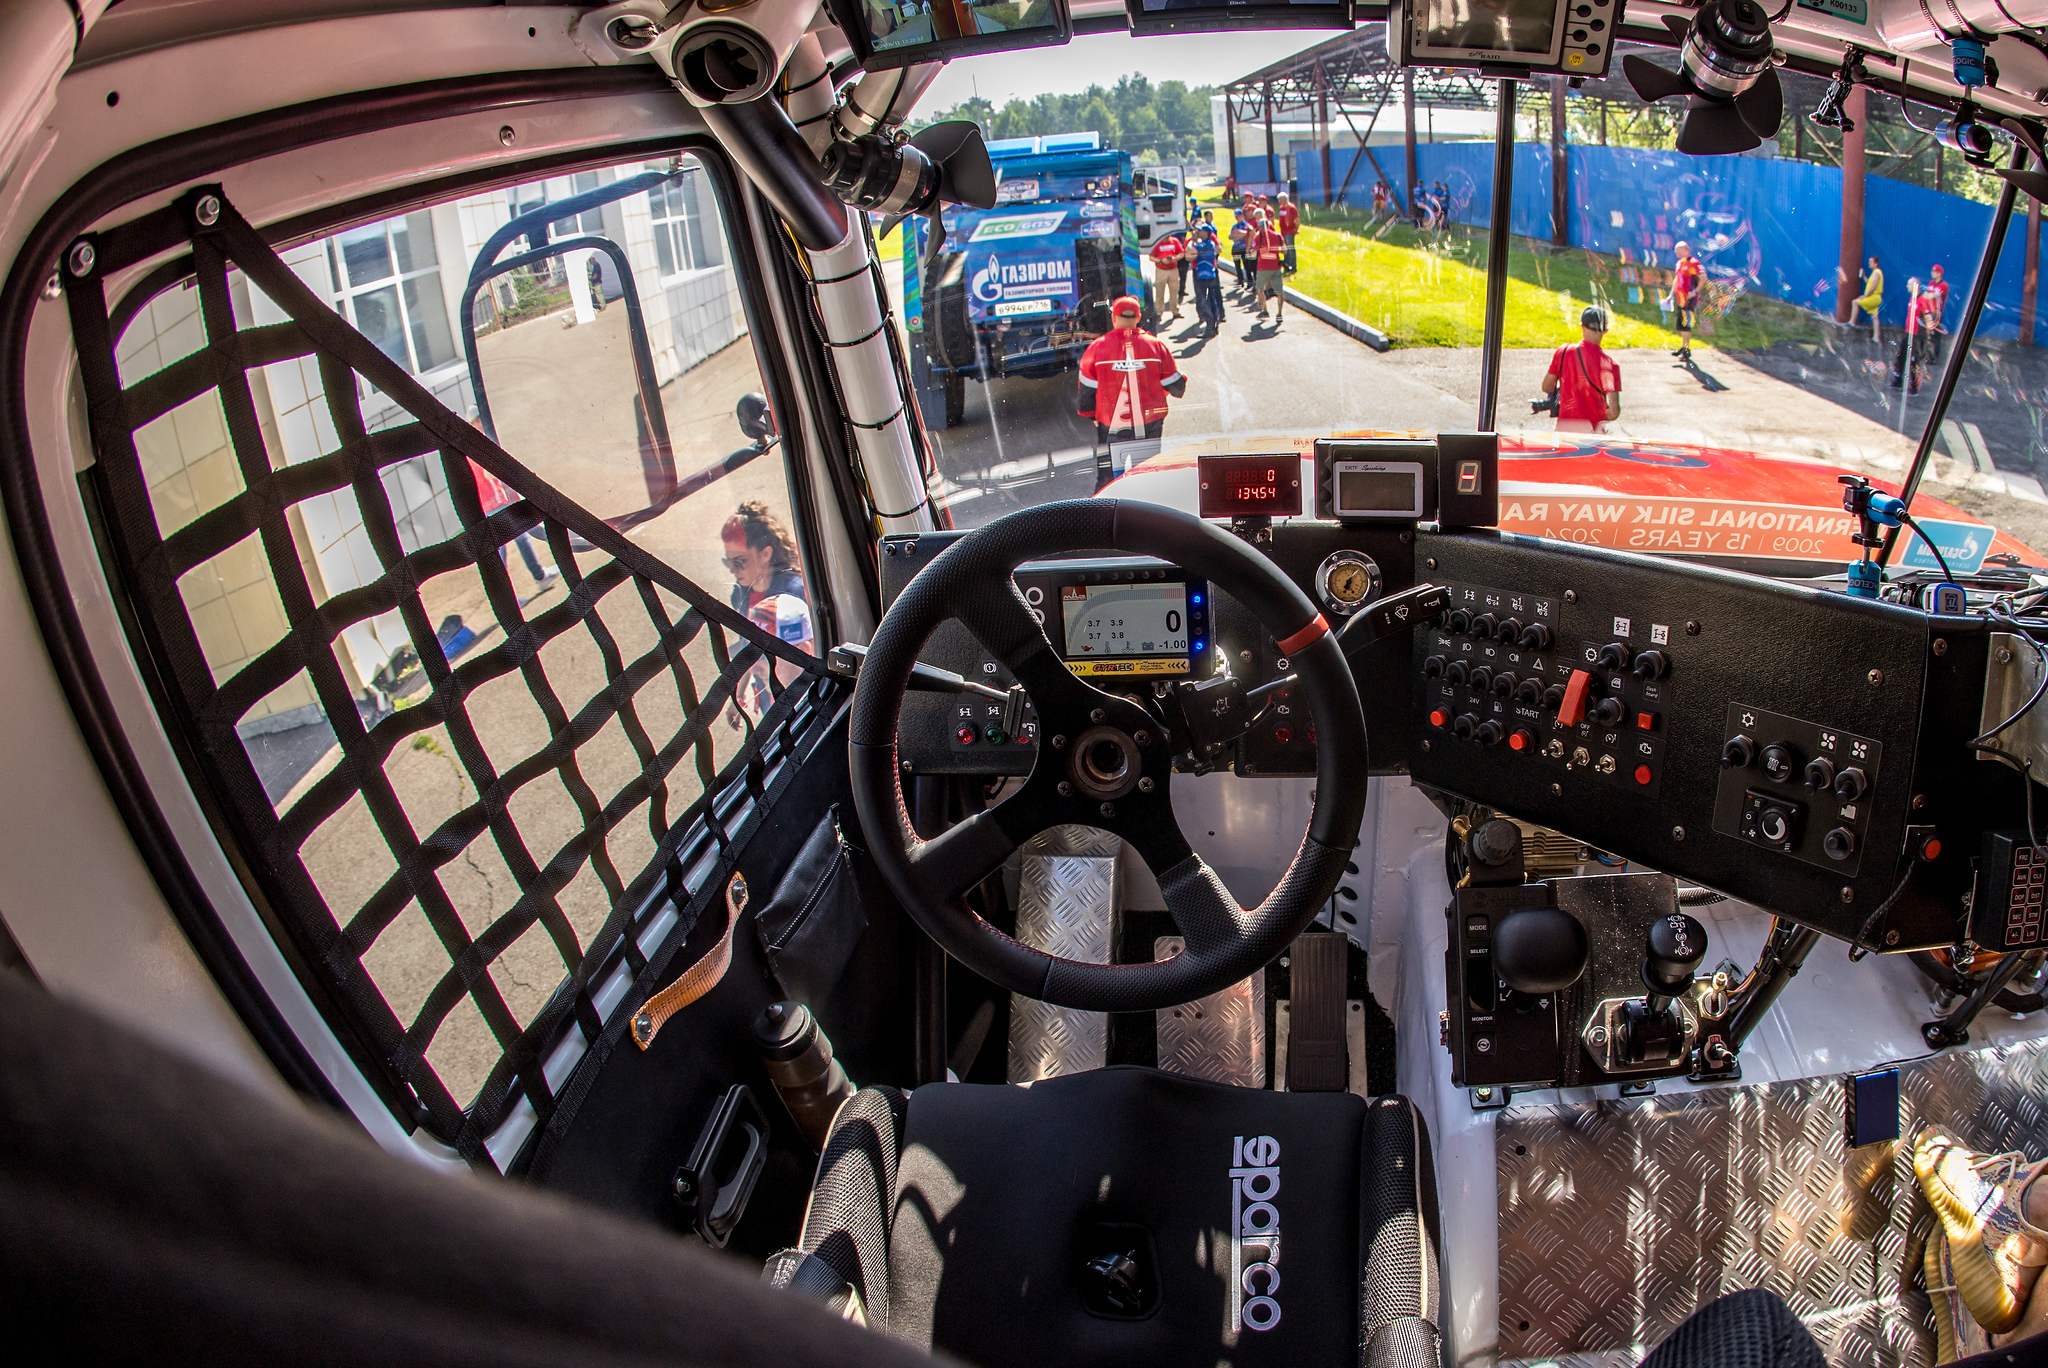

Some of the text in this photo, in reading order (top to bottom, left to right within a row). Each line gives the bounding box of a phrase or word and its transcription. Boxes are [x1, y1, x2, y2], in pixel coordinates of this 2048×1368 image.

[1829, 0, 1858, 13] K00133
[984, 224, 1015, 235] ECO
[1001, 260, 1072, 284] ГАЗПРОМ
[1267, 470, 1275, 481] 0
[1110, 619, 1124, 627] 3.9
[1165, 610, 1182, 633] 0
[1088, 631, 1124, 640] 3.7 3.8
[1158, 639, 1187, 649] -1.00
[1469, 696, 1480, 705] 24V
[1515, 707, 1539, 719] START
[1580, 723, 1591, 731] OFF
[1229, 1135, 1282, 1332] sparco
